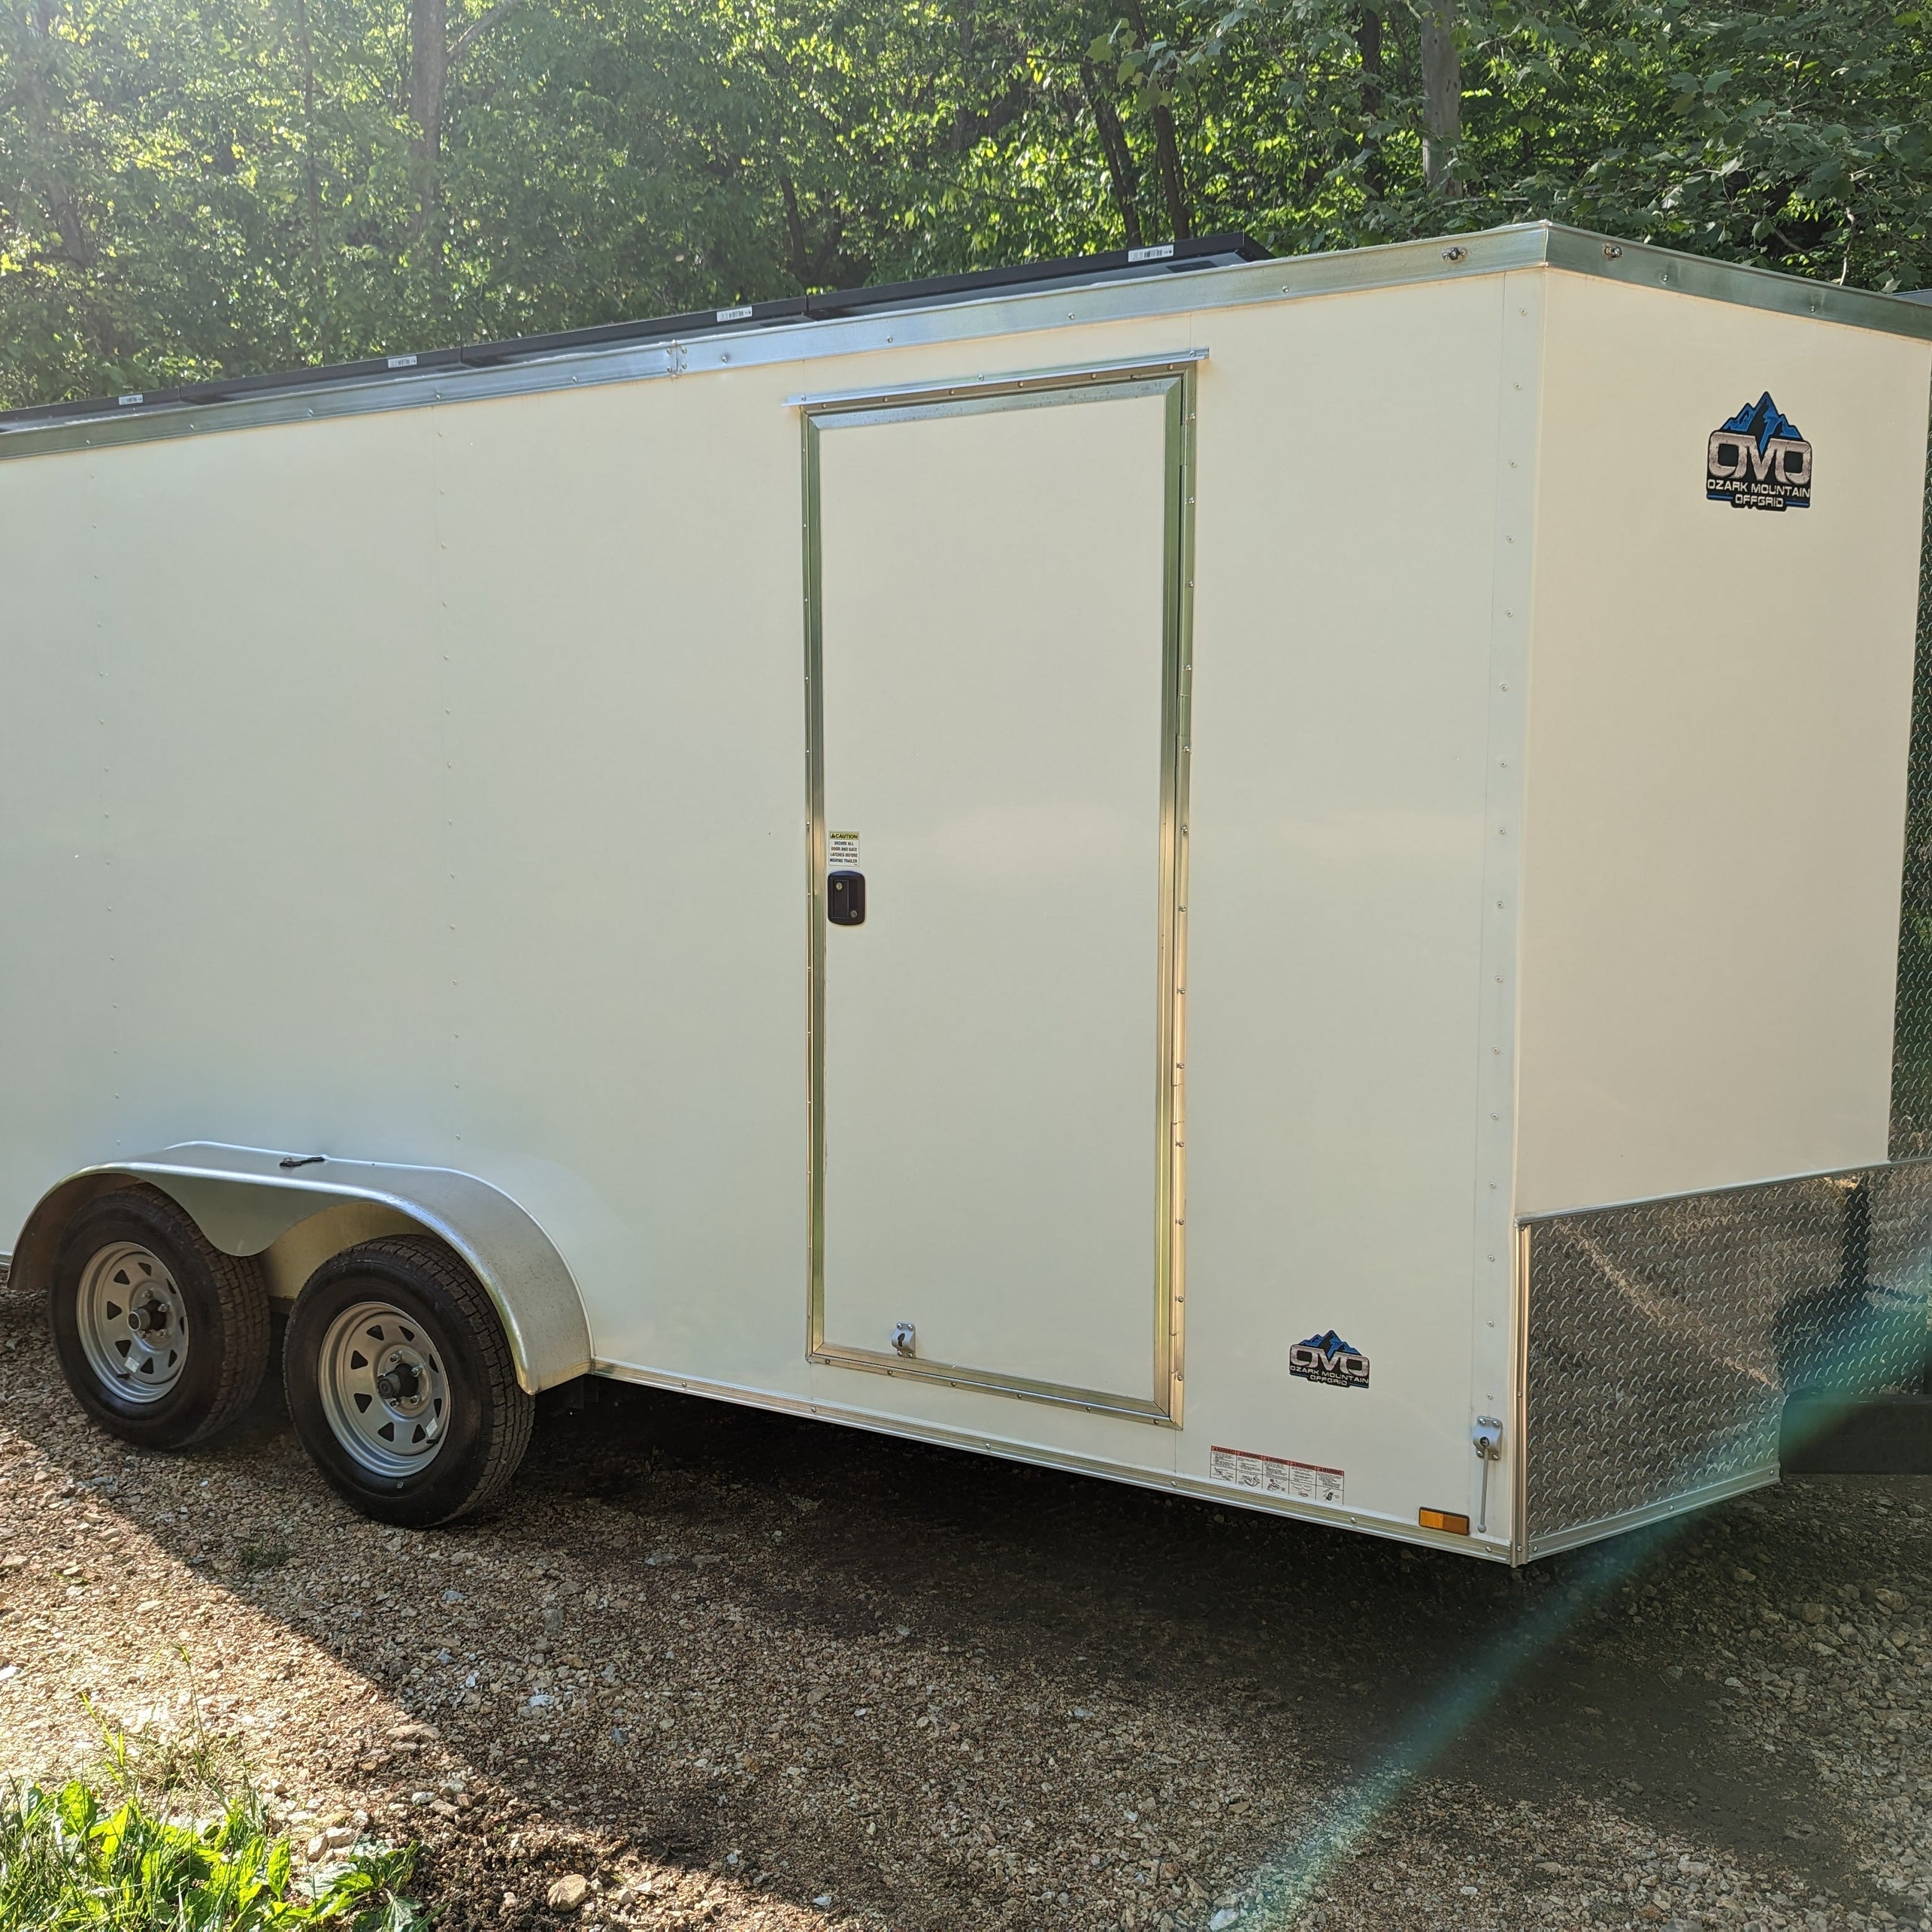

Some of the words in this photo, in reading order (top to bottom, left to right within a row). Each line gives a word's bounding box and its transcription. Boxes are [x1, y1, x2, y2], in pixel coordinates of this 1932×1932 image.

[1707, 479, 1748, 492] OZARK
[1751, 483, 1810, 498] MOUNTAIN
[1735, 494, 1784, 507] OFFGRID
[1290, 1365, 1319, 1375] OZARK
[1322, 1370, 1369, 1383] MOUNTAIN
[1310, 1374, 1347, 1385] OFFGRID
